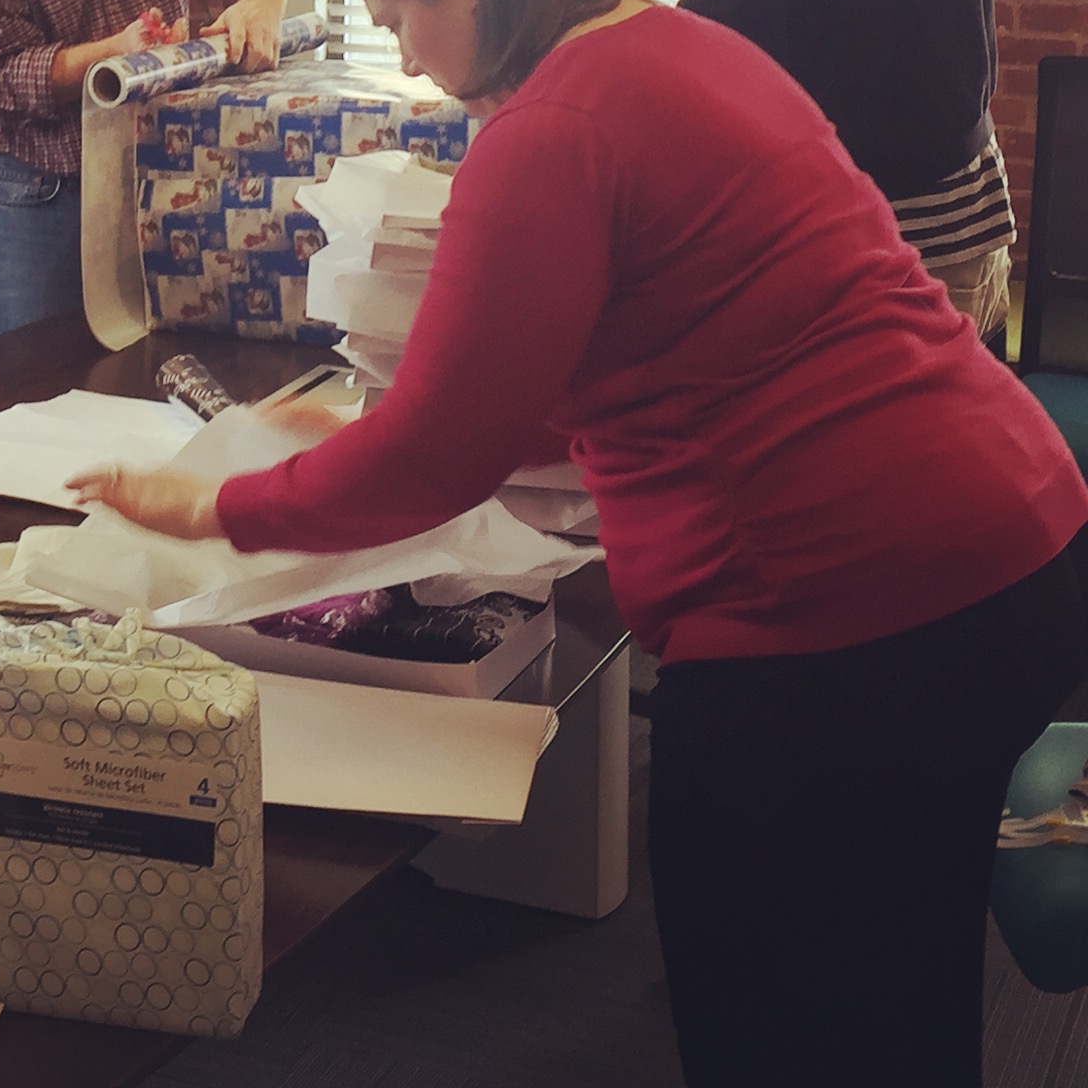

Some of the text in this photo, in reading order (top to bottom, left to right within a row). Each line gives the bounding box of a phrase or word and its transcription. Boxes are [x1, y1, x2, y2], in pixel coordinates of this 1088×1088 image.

[64, 757, 166, 782] Soft Microfiber
[82, 774, 146, 794] Sheet Set
[197, 778, 211, 795] 4
